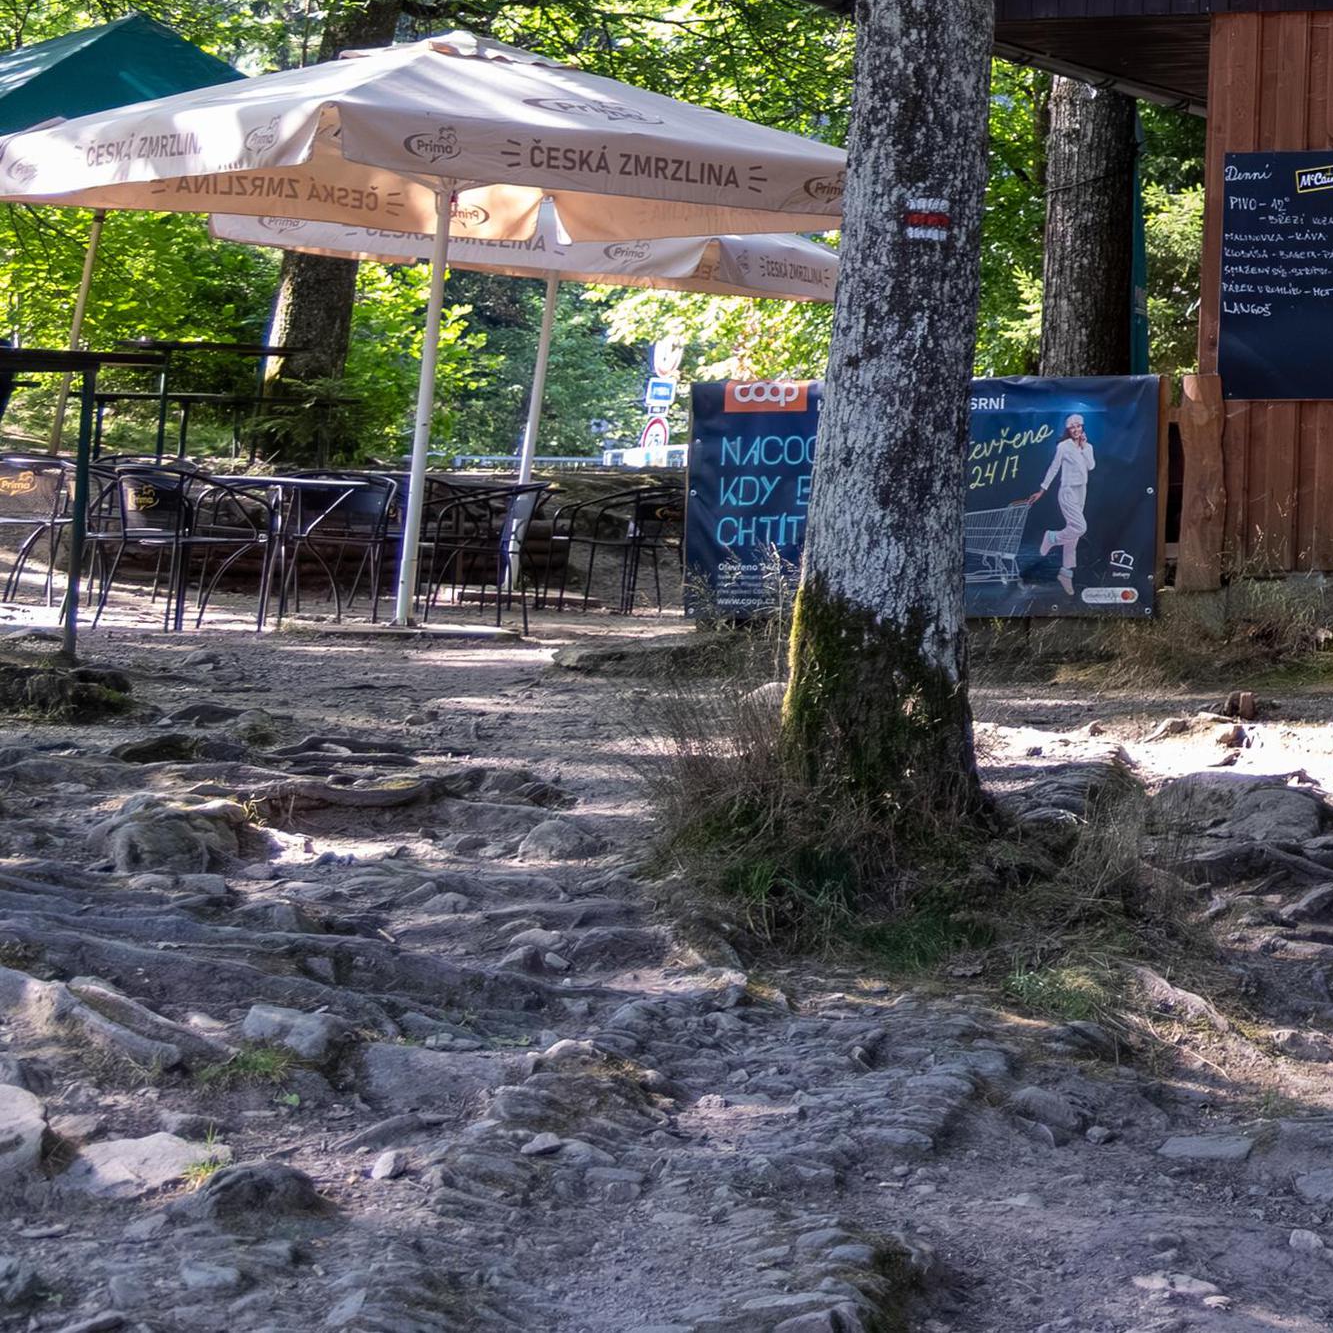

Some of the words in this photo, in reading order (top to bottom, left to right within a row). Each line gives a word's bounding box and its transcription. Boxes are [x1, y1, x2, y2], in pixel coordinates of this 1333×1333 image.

[138, 132, 202, 159] ZMRZLIN
[416, 139, 453, 155] Prima
[530, 139, 611, 175] ČESKÁ
[619, 153, 740, 188] ZMRZLINA
[1229, 196, 1257, 211] PIVO
[613, 247, 644, 259] Prima
[1223, 301, 1272, 317] LANGOŠ
[734, 381, 800, 407] coop
[970, 393, 1006, 410] SRNÍ
[969, 455, 1019, 490] 24/7
[2, 479, 30, 490] Prima
[719, 476, 782, 506] KDY
[716, 512, 806, 547] CHTÍT
